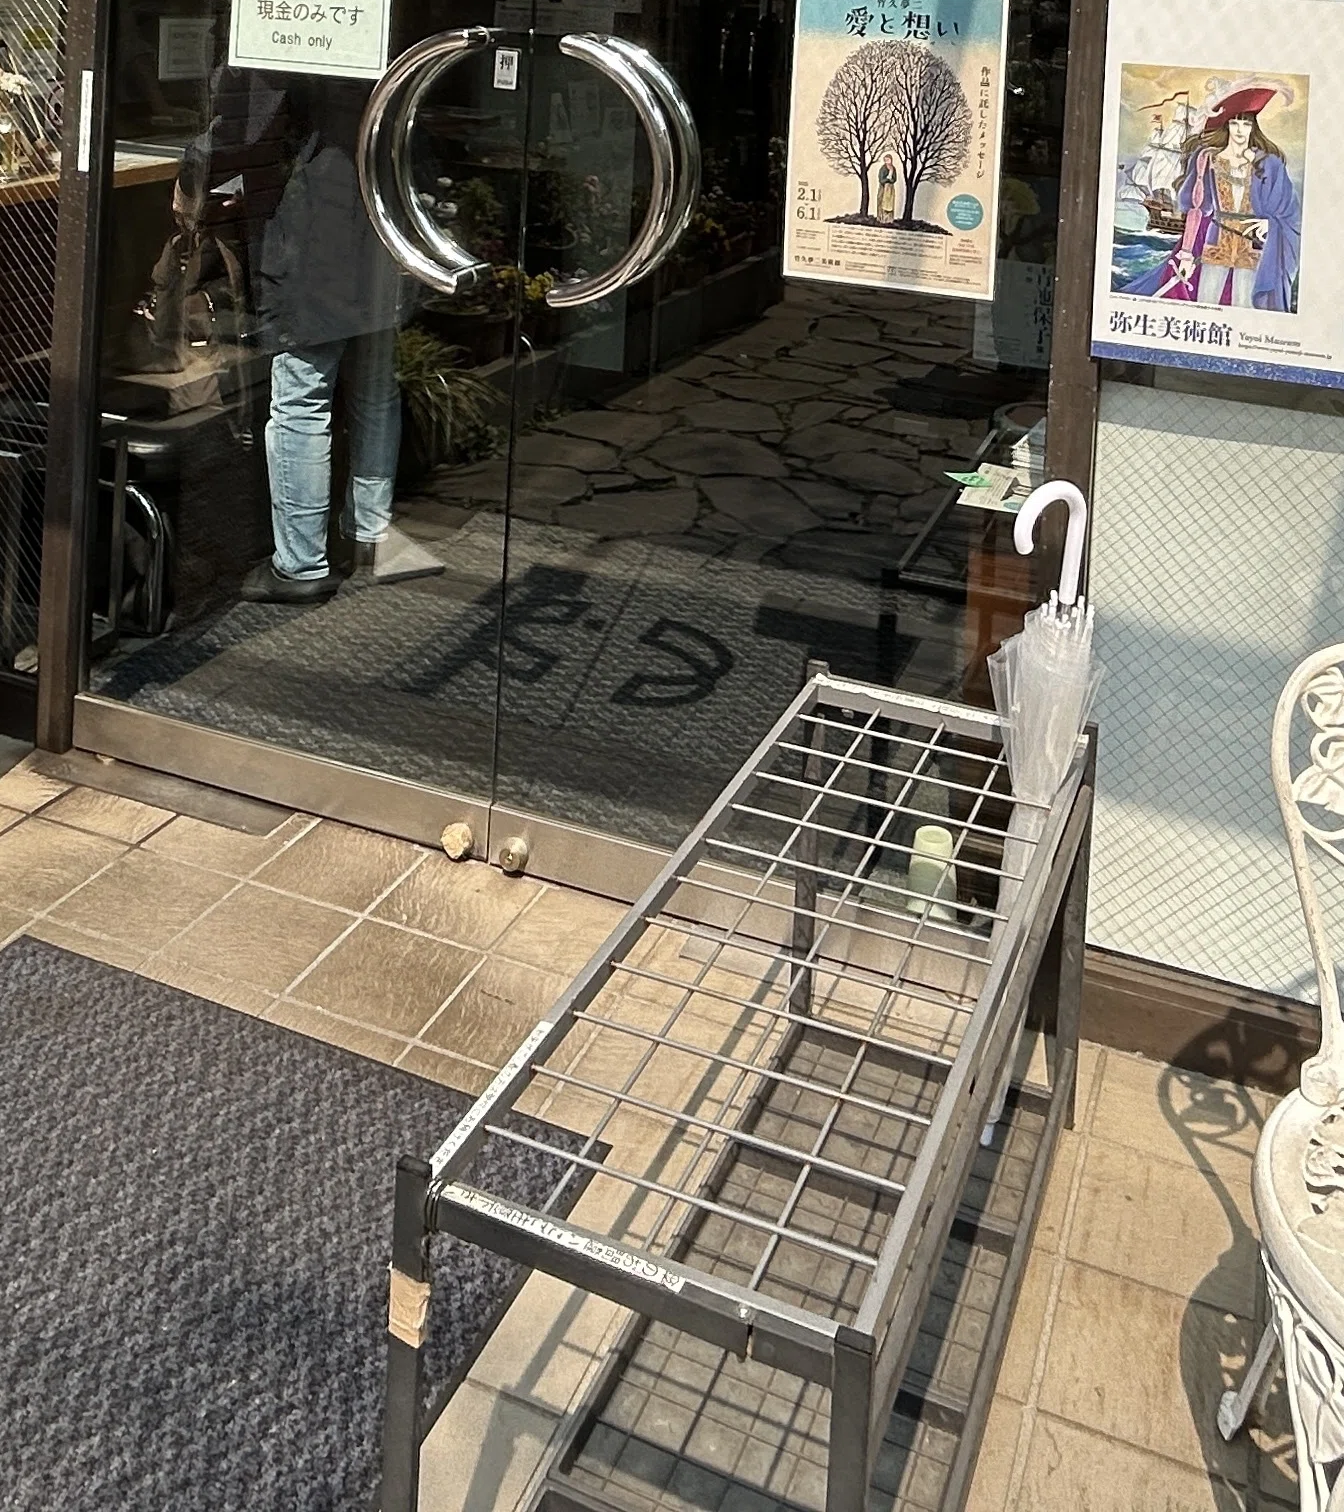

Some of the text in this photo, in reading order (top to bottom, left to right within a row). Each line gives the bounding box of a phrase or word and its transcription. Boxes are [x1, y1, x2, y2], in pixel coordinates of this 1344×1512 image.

[256, 0, 365, 26] 現金のみです
[845, 5, 960, 41] 愛と想い
[271, 31, 333, 51] Cash only
[499, 54, 514, 70] 押
[797, 187, 818, 202] 2.1
[796, 206, 818, 221] 6.1
[1108, 310, 1233, 348] 弥生美術館
[1239, 332, 1263, 343] Yayoi
